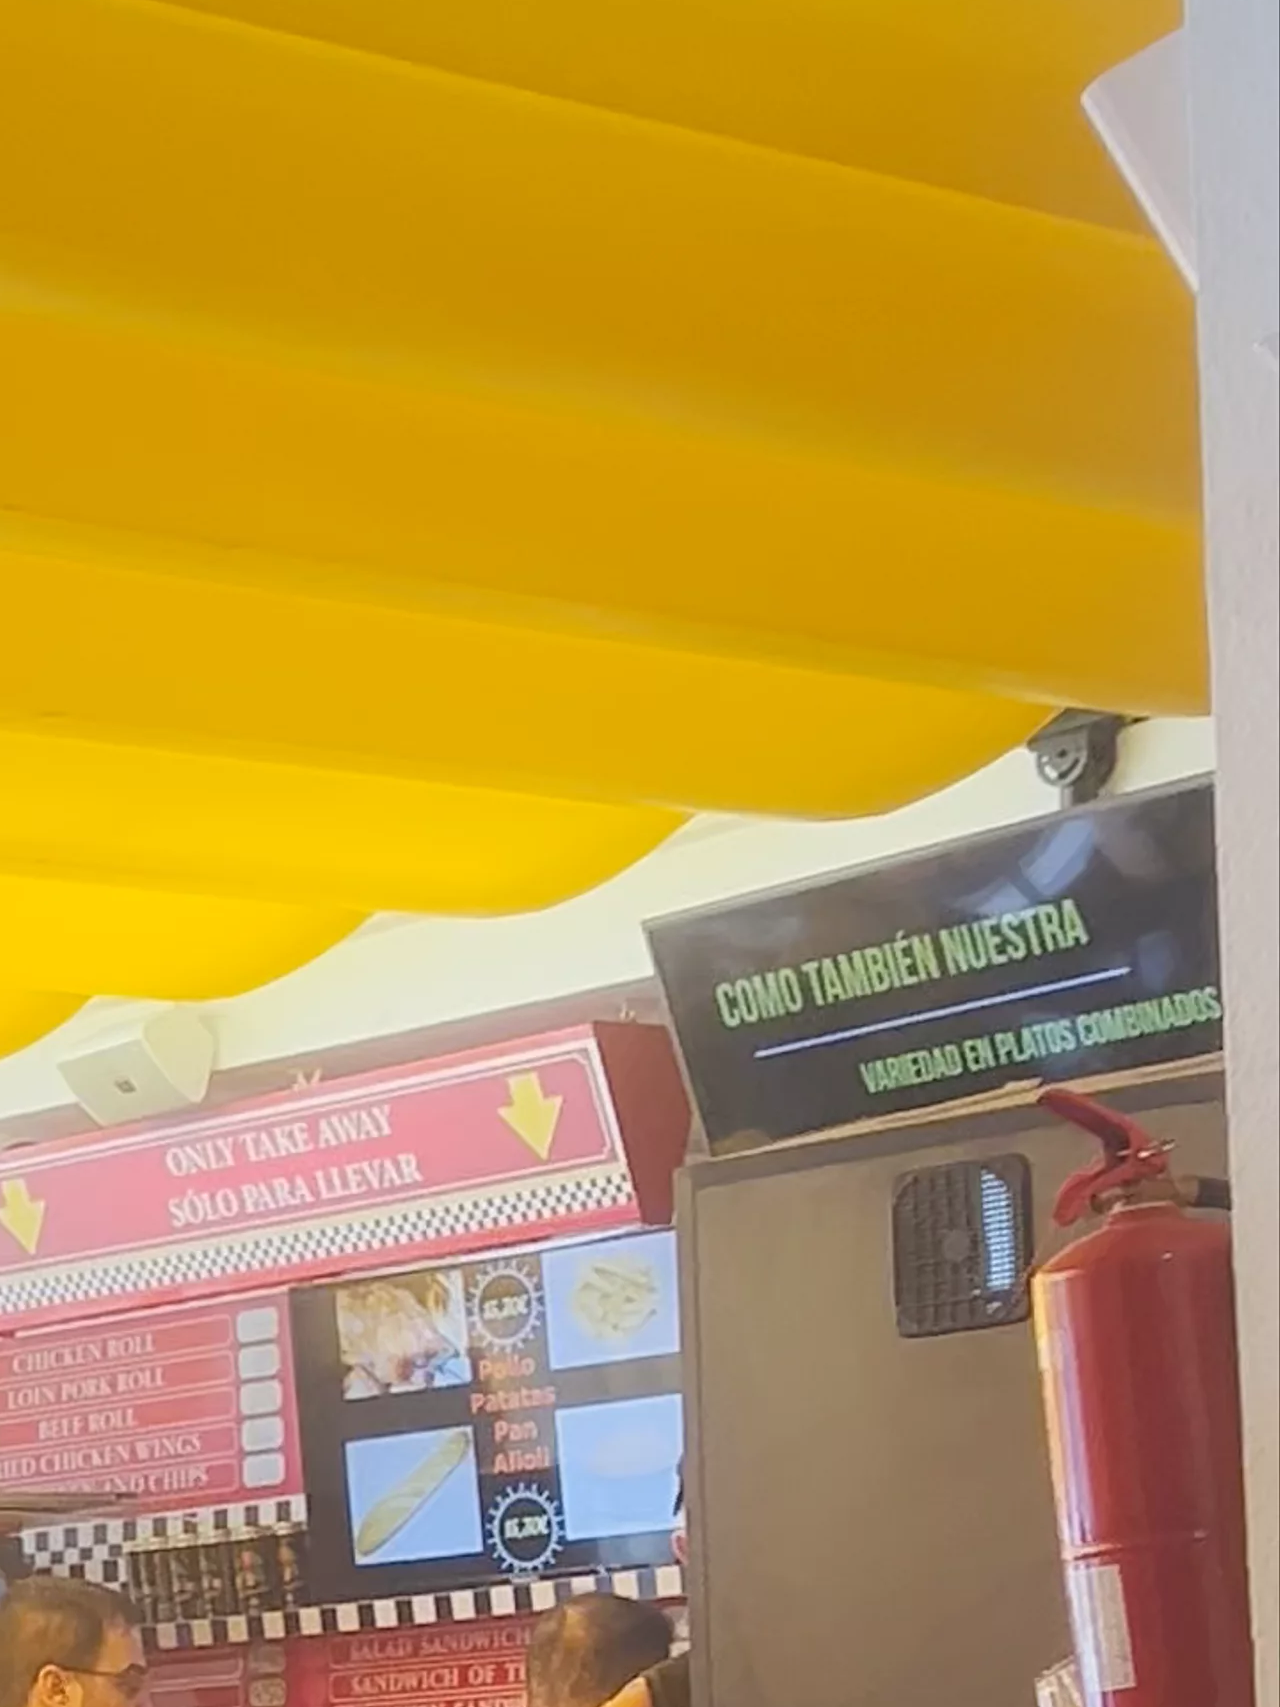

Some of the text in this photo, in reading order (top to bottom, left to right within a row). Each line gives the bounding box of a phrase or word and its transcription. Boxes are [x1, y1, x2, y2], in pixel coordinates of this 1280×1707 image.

[715, 899, 1090, 1028] COMO TAMBIÉN NUESTRA
[859, 987, 1221, 1093] VARIEDAD EN PLATOS COMBINADOS
[165, 1105, 392, 1177] ONLY TAKE AWAY
[168, 1154, 423, 1228] SÓLO PARA LLEVAR
[12, 1333, 155, 1374] CHICKEN ROLL
[479, 1354, 535, 1381] Pollo
[8, 1367, 165, 1410] LOIN PORK ROLL
[471, 1386, 556, 1414] Patatas
[39, 1408, 137, 1440] BEEF ROLL
[494, 1420, 538, 1442] Pan
[41, 1445, 131, 1473] CHICKEN
[135, 1434, 201, 1460] WINGS
[493, 1448, 550, 1474] Alioli
[149, 1465, 208, 1492] CHIPS
[420, 1626, 531, 1655] SANDWICH
[351, 1667, 458, 1694] SANDWICH
[468, 1664, 496, 1685] OF
